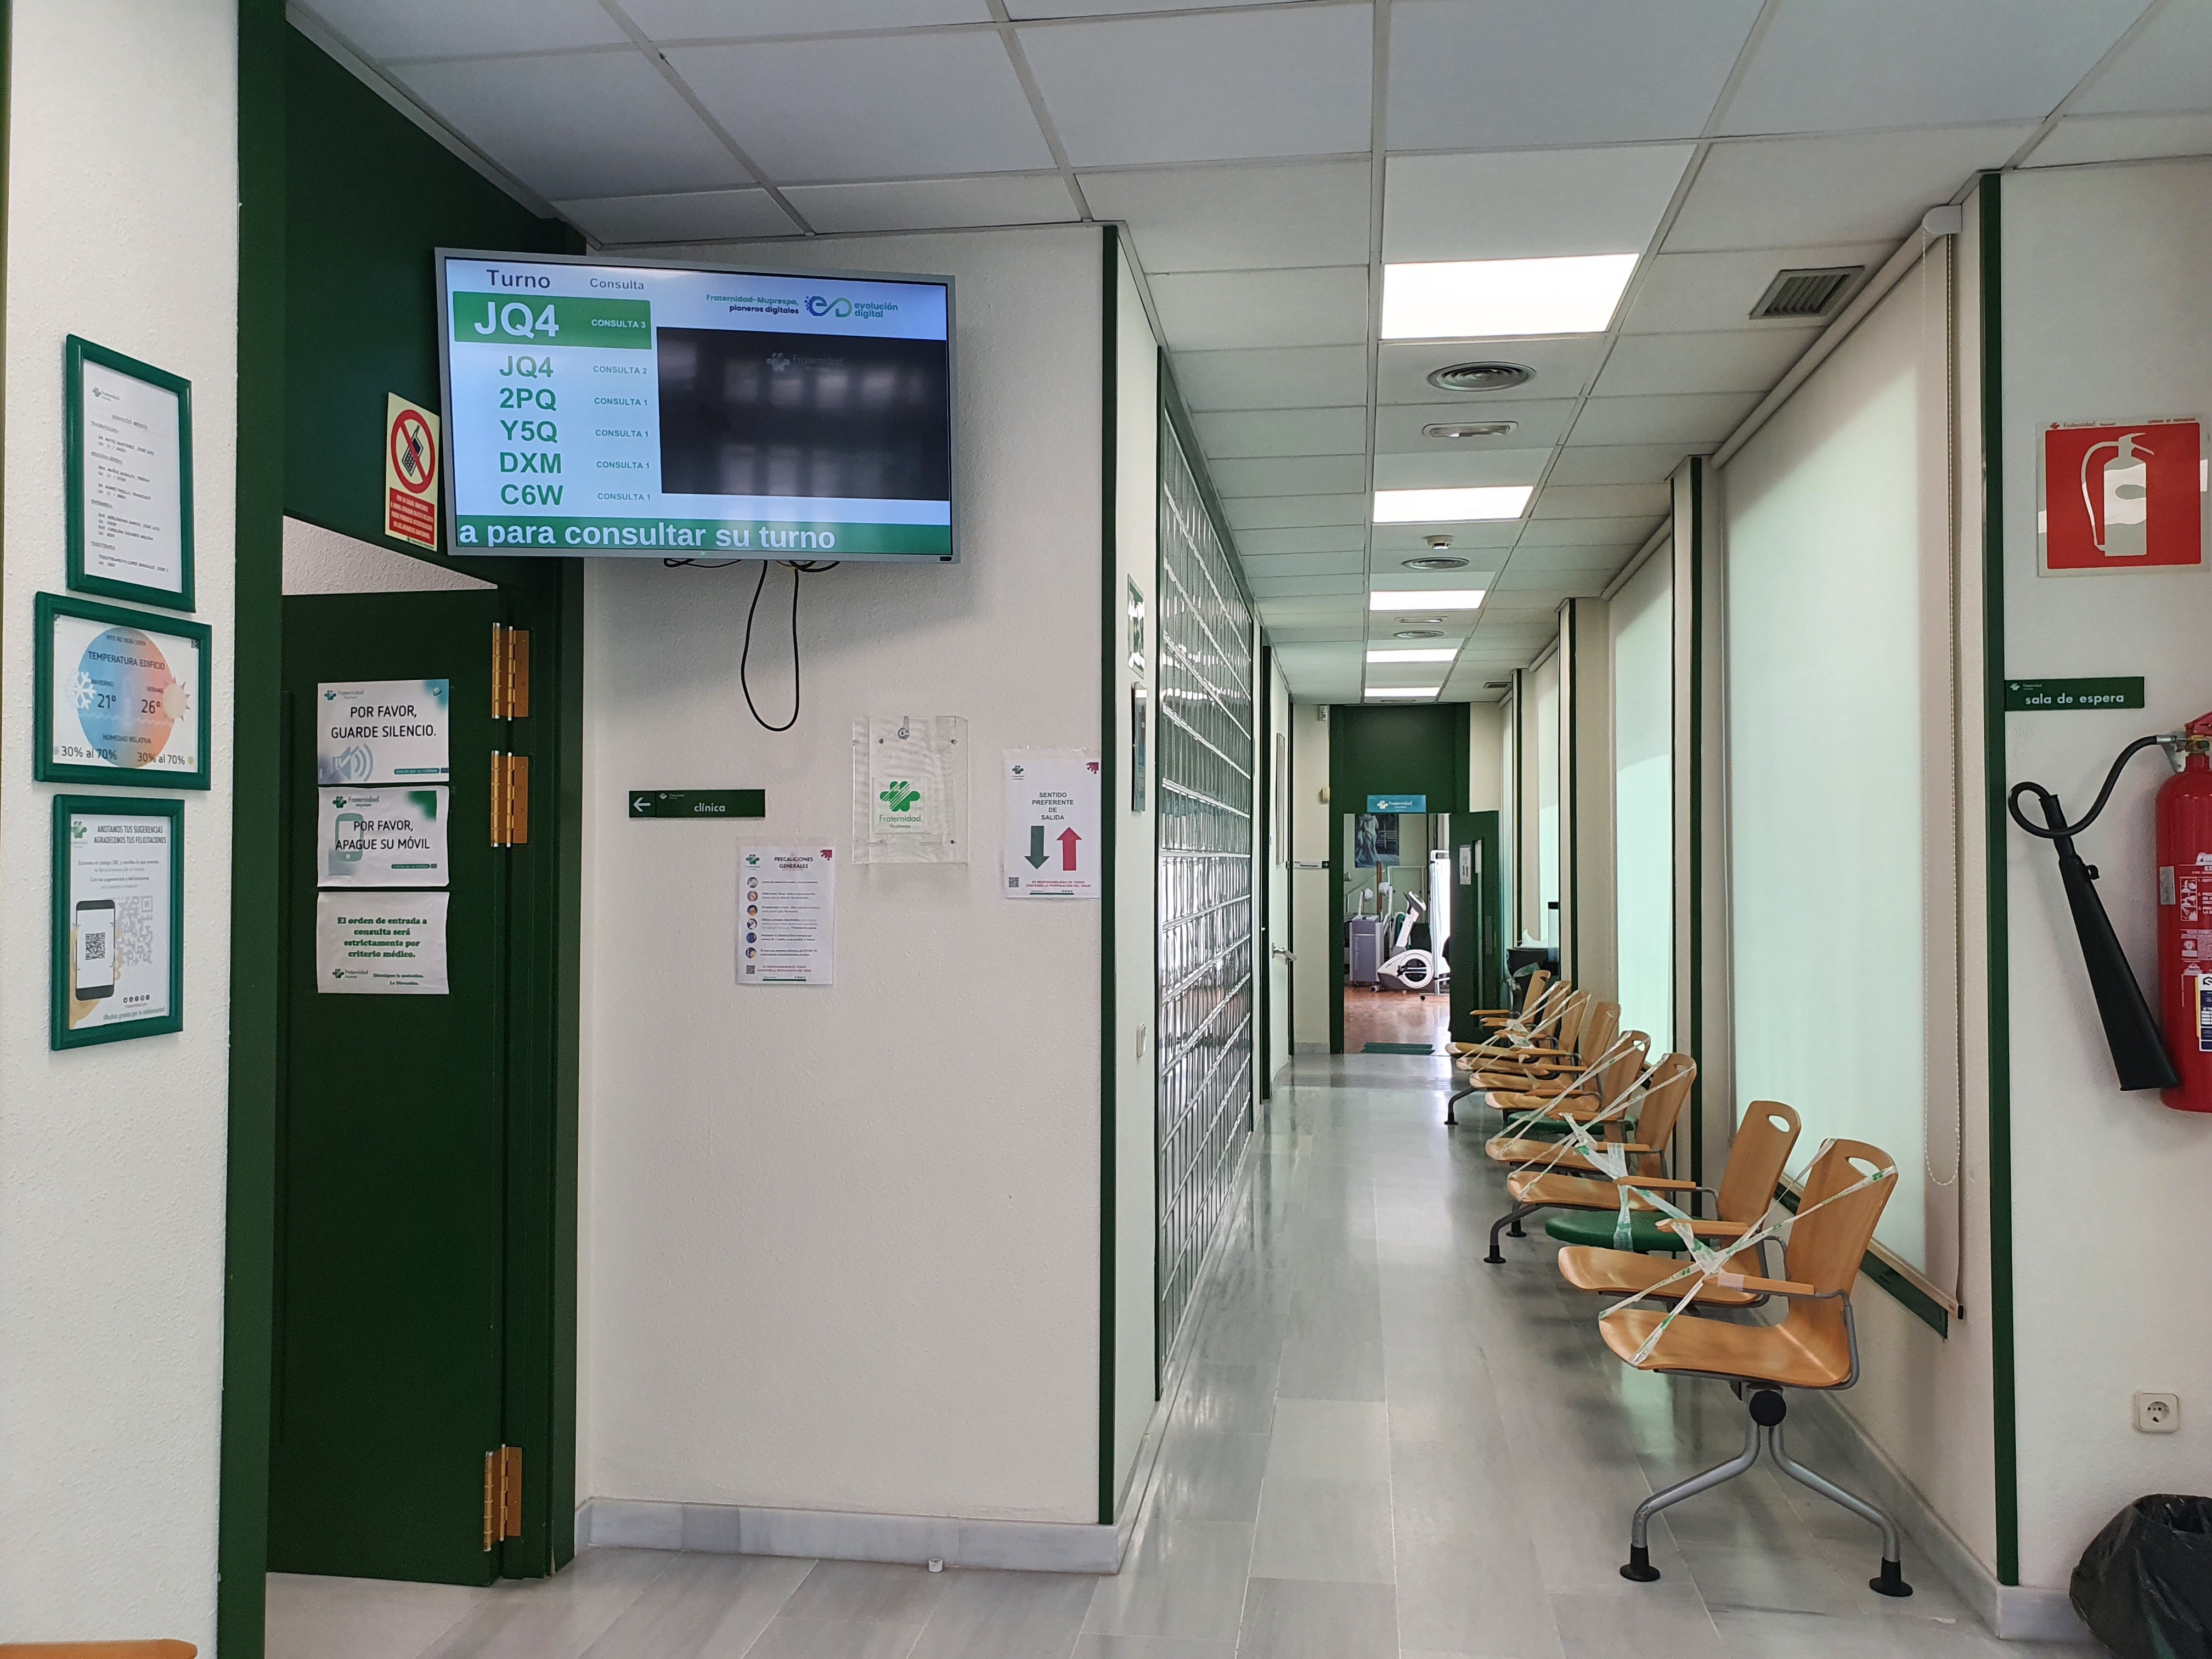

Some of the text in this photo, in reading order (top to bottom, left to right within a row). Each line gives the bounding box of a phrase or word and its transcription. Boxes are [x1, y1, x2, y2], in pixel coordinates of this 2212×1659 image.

[486, 269, 550, 289] Turno
[590, 278, 645, 290] Consulta
[706, 294, 799, 306] Fraternidad-Muprespa,
[854, 302, 899, 311] evolución
[729, 304, 799, 315] pioneros digitales
[854, 309, 884, 319] digital
[474, 302, 559, 338] JQ4
[591, 319, 639, 328] CONSULTA
[499, 356, 554, 379] JQ4
[593, 365, 640, 374] CONSULTA
[500, 387, 557, 411] 2PQ
[594, 397, 641, 405] CONSULTA
[500, 420, 557, 443] Y5Q
[595, 429, 642, 437] CONSULTA
[500, 452, 562, 473] DXM
[596, 461, 643, 469] CONSULTA
[501, 484, 563, 505] C6W
[459, 522, 836, 549] a para consultar su turno
[88, 651, 165, 670] TEMPERATURA EDIFICIO
[2025, 692, 2124, 706] sala de espera
[351, 705, 417, 719] POR FAVOR,
[331, 725, 437, 738] GUARDE SILENCIO.
[61, 746, 117, 760] 30% al 70%
[137, 752, 185, 765] 30% al 70%
[694, 803, 725, 812] clínica
[354, 820, 413, 832] POR FAVOR,
[335, 836, 430, 850] APAGUE SU MÓVIL
